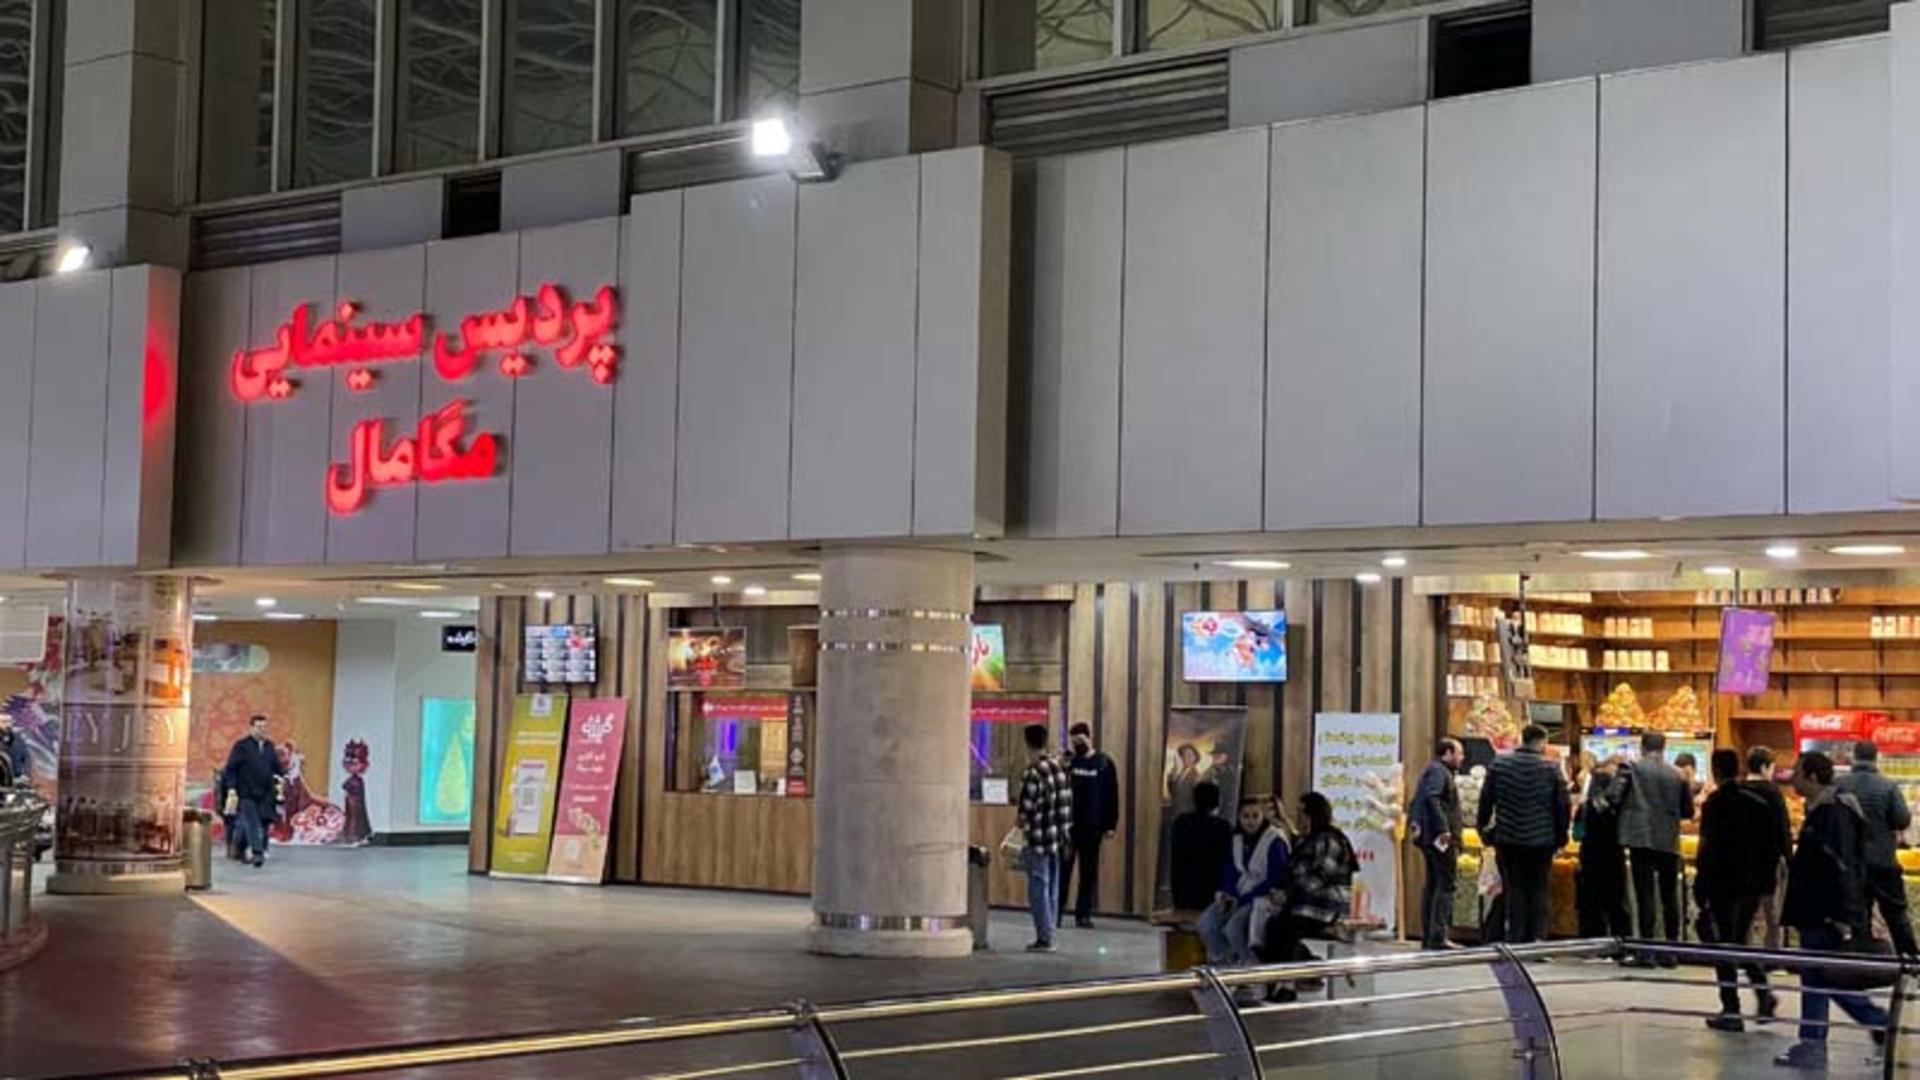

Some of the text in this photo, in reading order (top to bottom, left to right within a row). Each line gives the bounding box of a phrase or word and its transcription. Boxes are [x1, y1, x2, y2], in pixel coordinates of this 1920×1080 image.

[232, 283, 617, 401] پردیس سینمایی
[326, 399, 498, 515] مگامال
